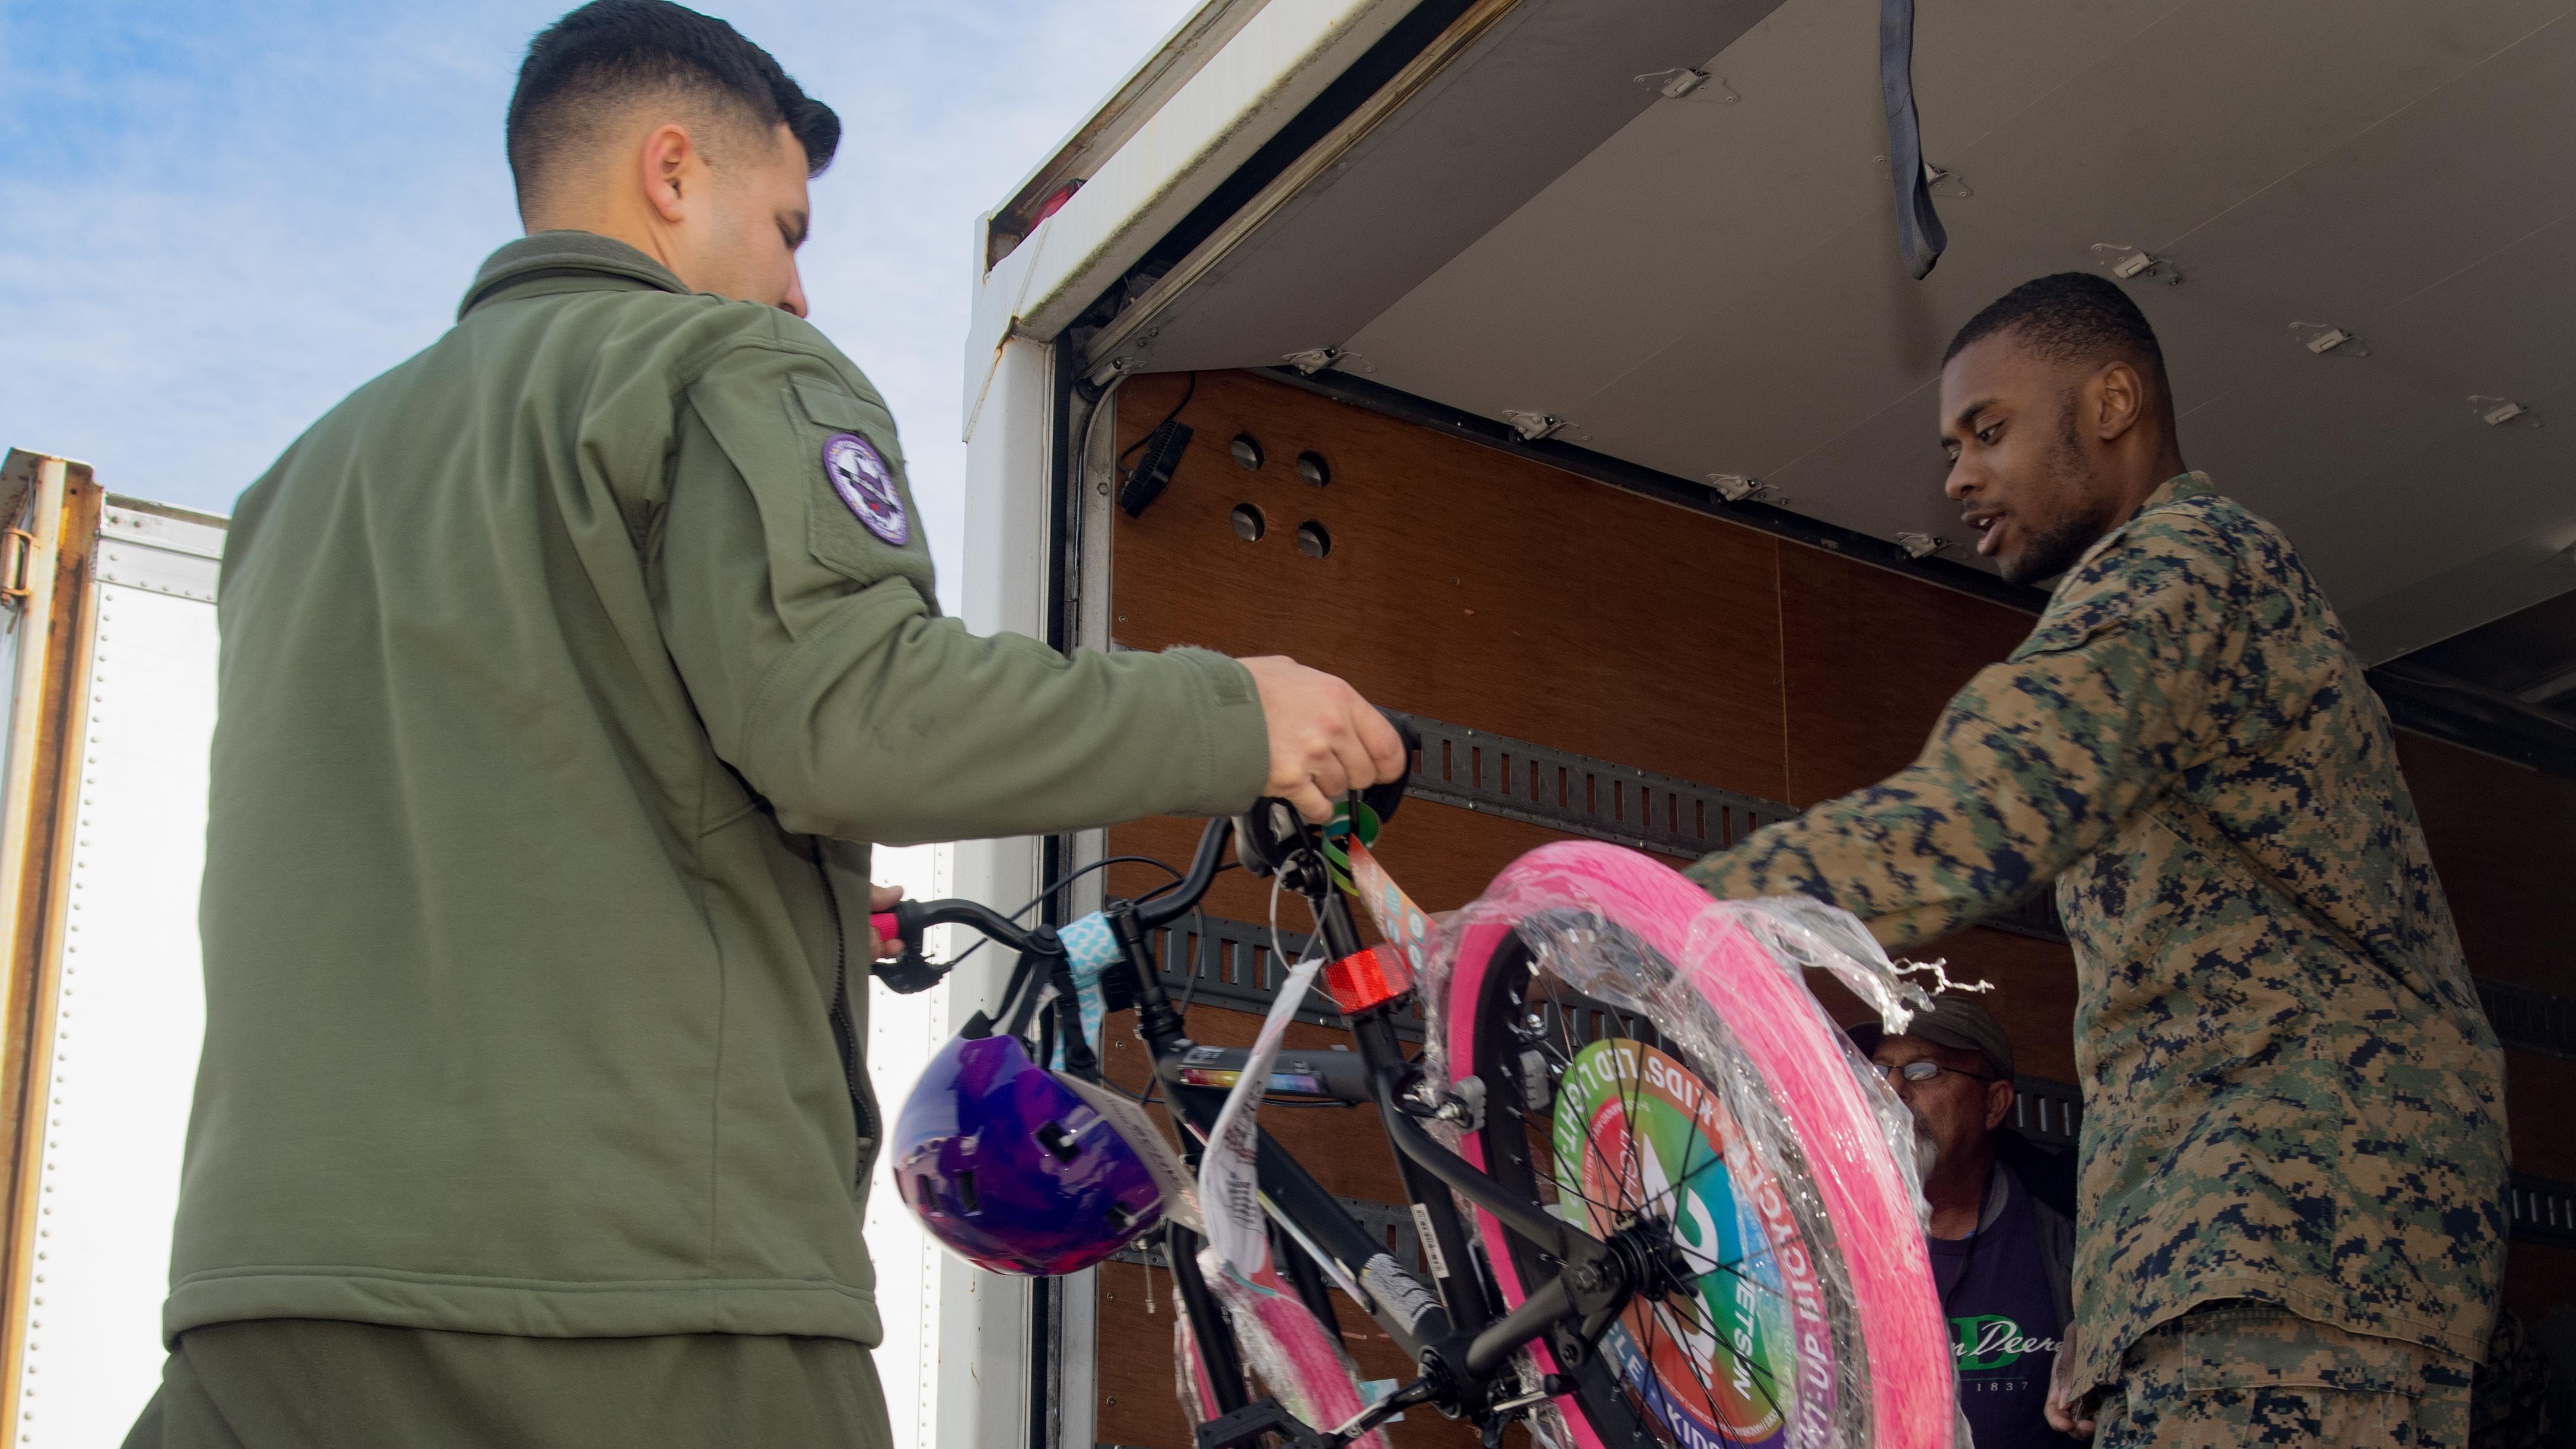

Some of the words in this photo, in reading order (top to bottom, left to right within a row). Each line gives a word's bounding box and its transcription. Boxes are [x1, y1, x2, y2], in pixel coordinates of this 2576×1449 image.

[1594, 1047, 1639, 1082] LED
[1733, 1263, 1756, 1401] JETSON
[1977, 1381, 2028, 1391] 1837
